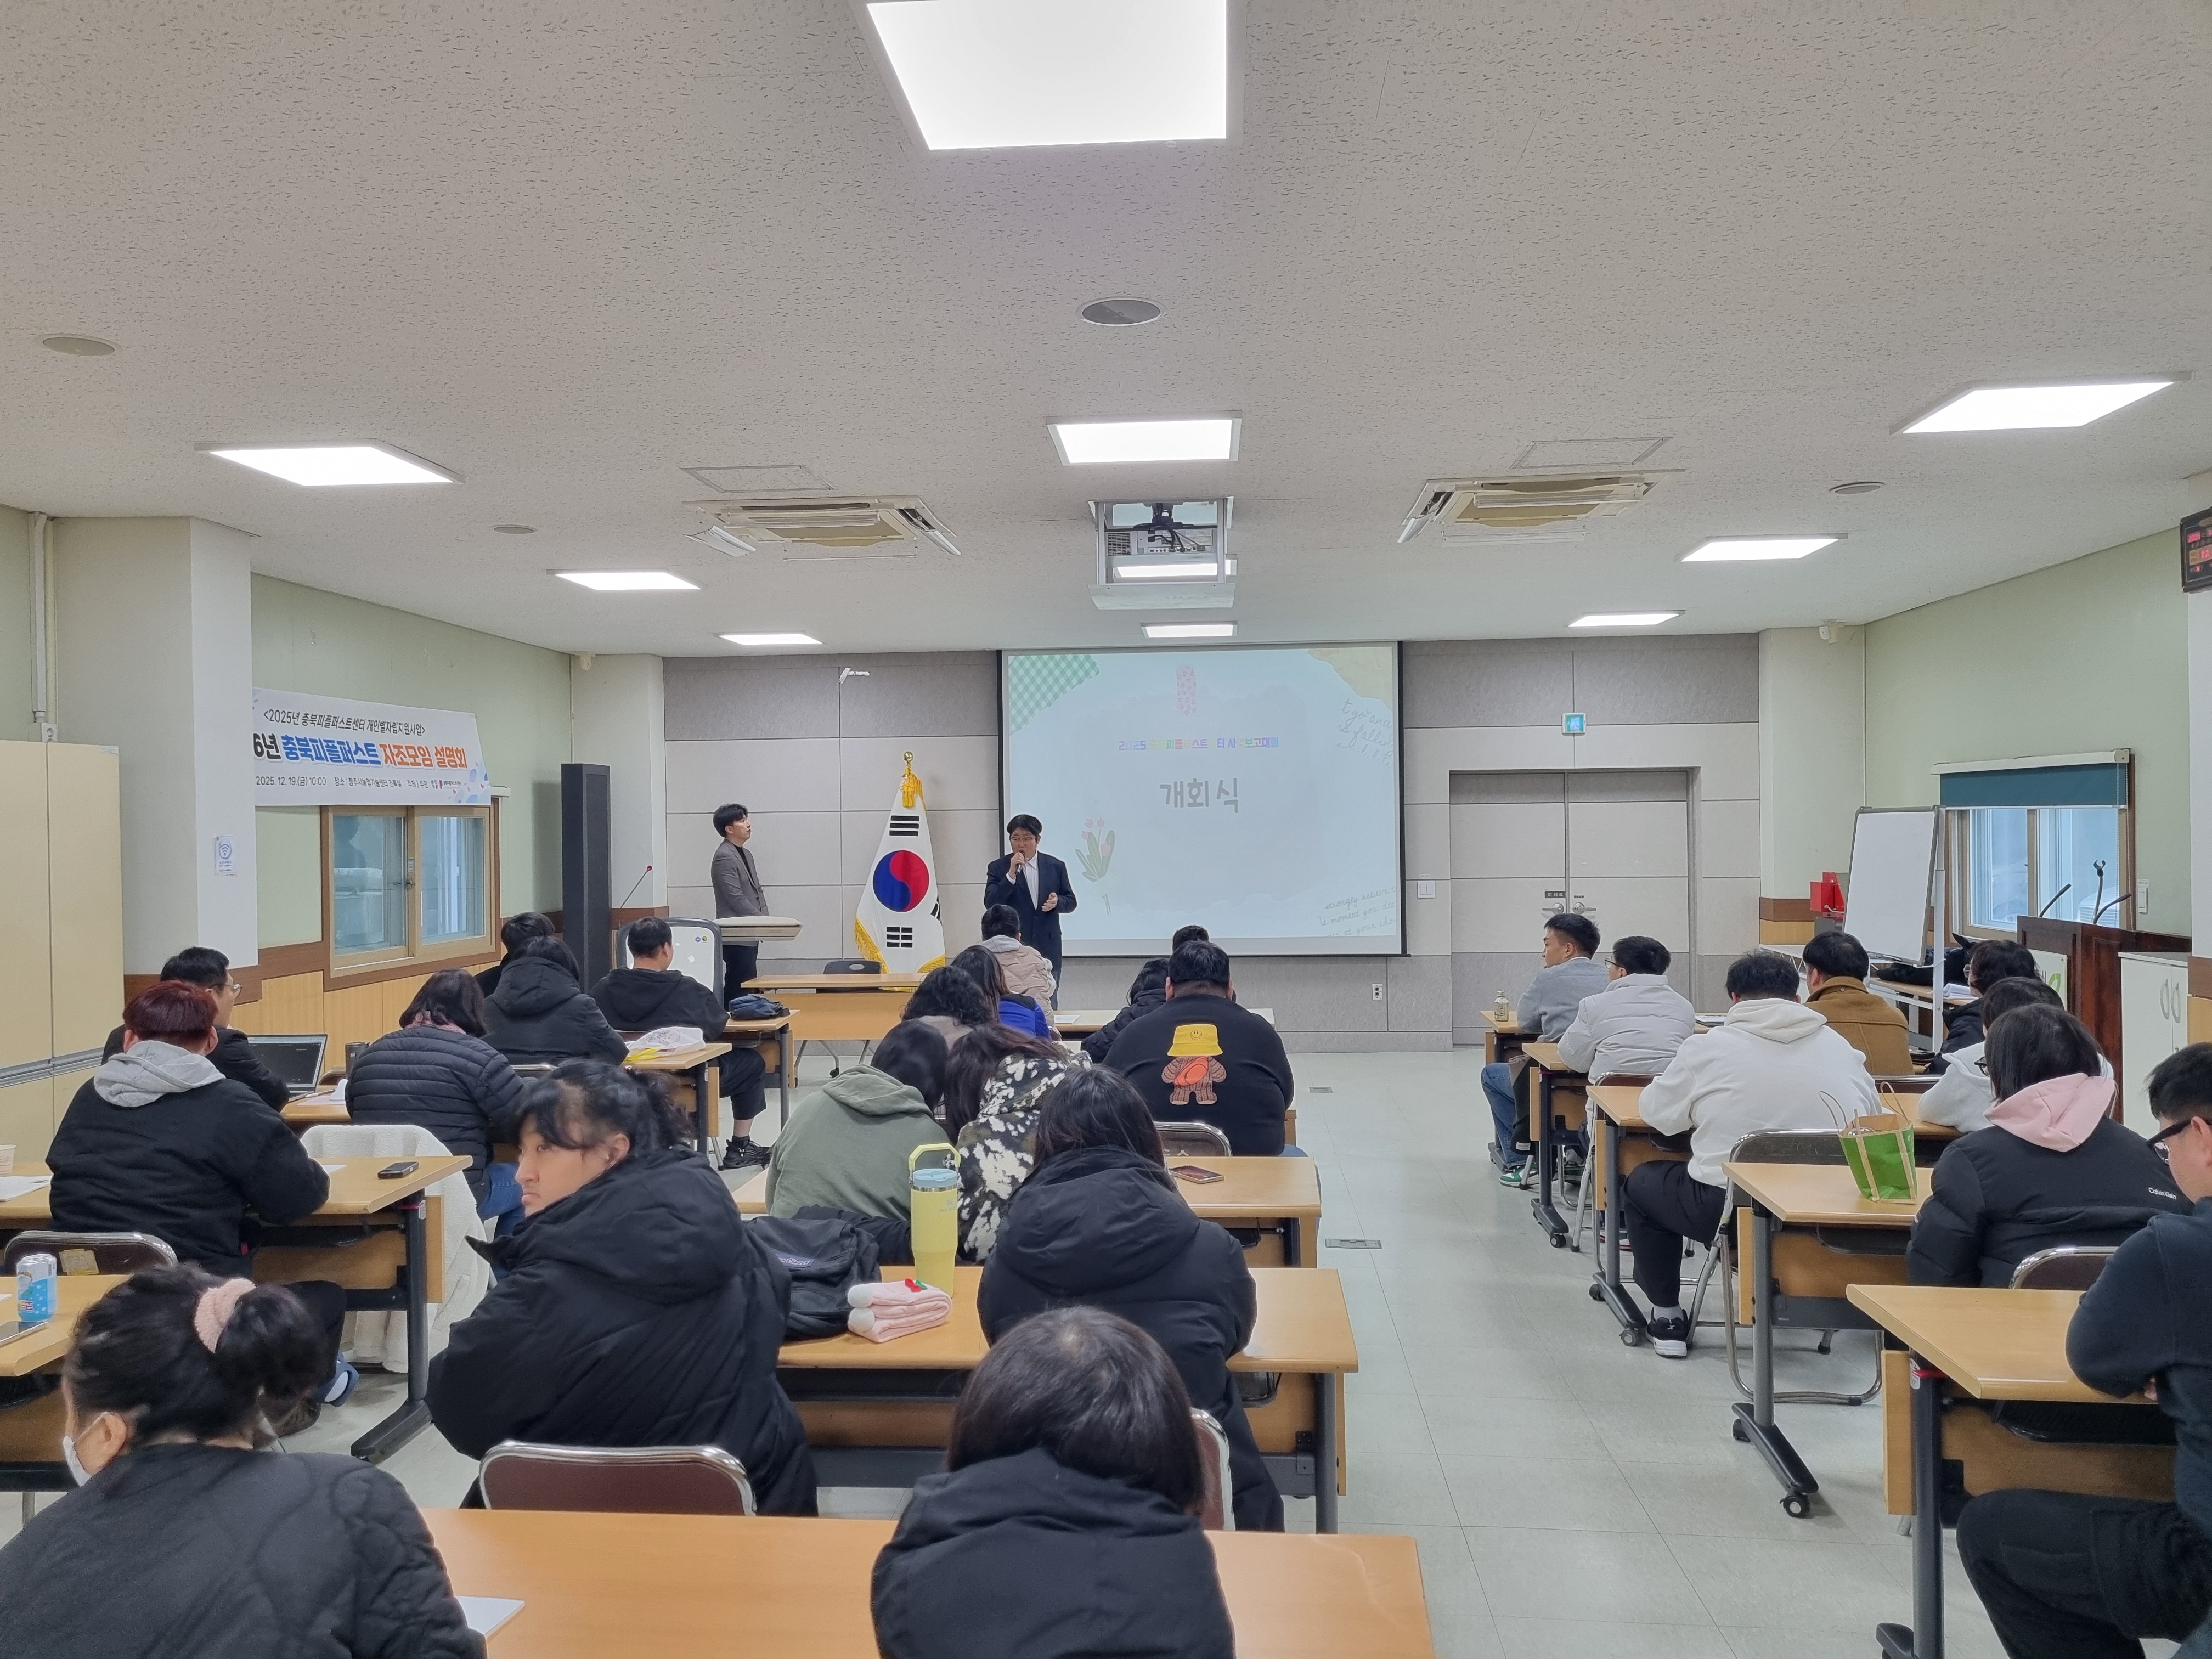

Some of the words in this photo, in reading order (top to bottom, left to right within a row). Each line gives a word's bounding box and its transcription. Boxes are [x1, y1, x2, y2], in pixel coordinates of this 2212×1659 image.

[263, 709, 300, 725] <2025년
[302, 713, 366, 731] 충북피플퍼스트센터
[367, 720, 425, 736] 개인별자립지원사업>
[281, 735, 381, 765] 충북피플퍼스트
[379, 744, 433, 768] 자조모임
[435, 746, 467, 768] 설명회
[1119, 740, 1147, 751] 2025
[256, 776, 276, 785] 2025.
[278, 776, 286, 785] 12.
[309, 777, 326, 786] 10:00
[334, 777, 345, 786] 장소
[1159, 777, 1239, 814] 개회식
[2148, 1187, 2165, 1196] Calvin
[2164, 1190, 2177, 1200] Klein
